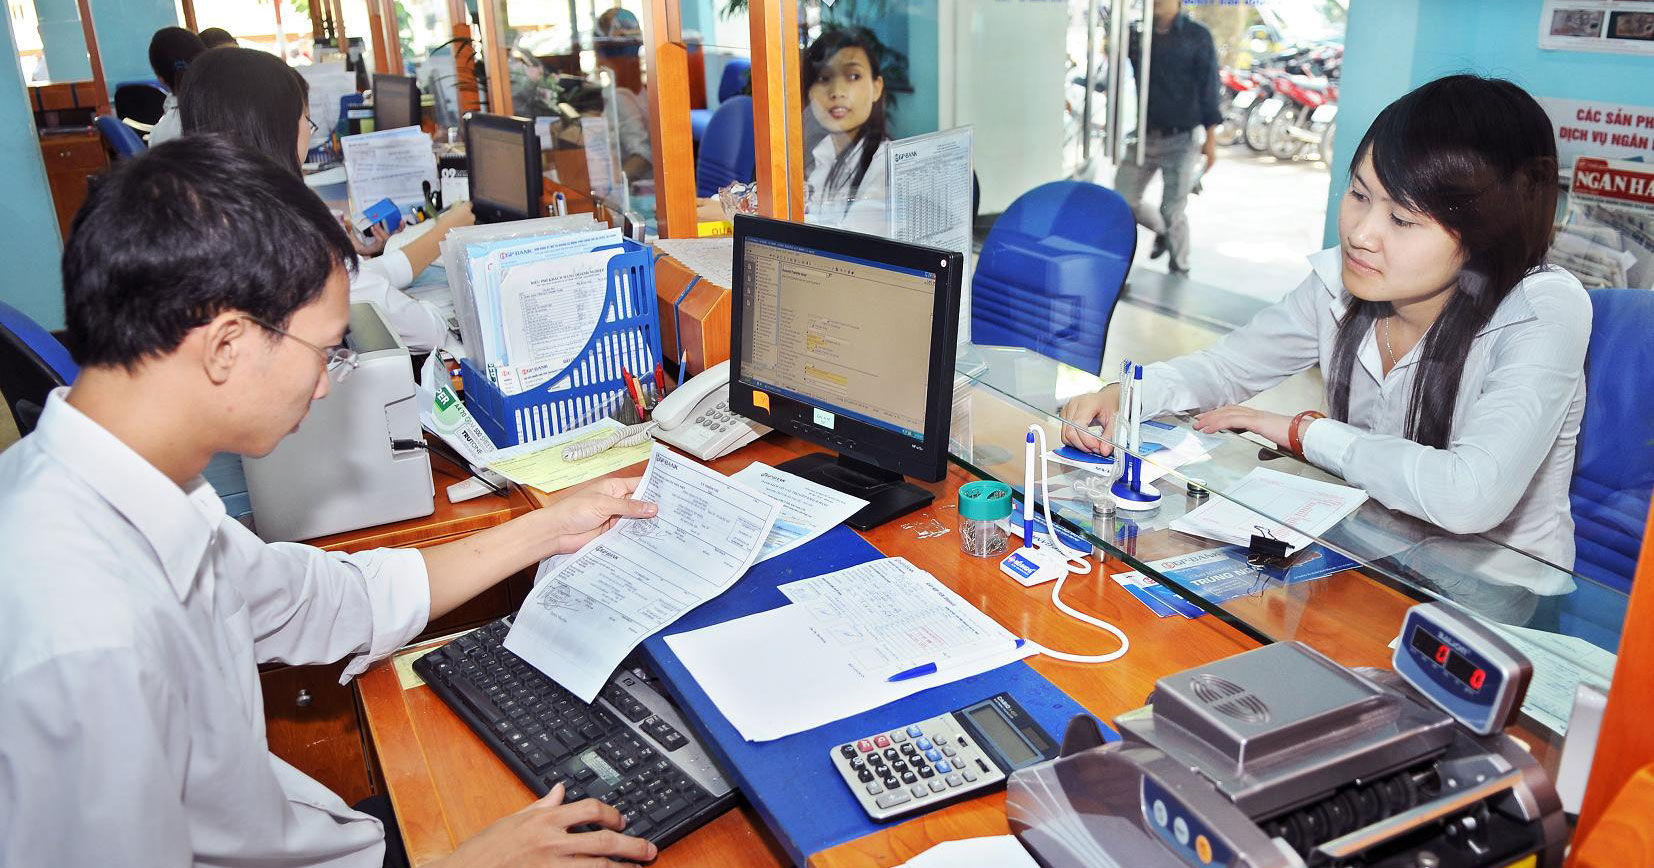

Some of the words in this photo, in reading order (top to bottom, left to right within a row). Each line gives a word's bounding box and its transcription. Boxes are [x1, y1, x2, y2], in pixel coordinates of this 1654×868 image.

[1576, 106, 1602, 123] CÁC
[1559, 126, 1588, 142] DỊCH
[1592, 130, 1608, 146] VỤ
[1611, 133, 1648, 150] NGÂN
[1435, 644, 1450, 666] 0
[1469, 668, 1486, 690] 0
